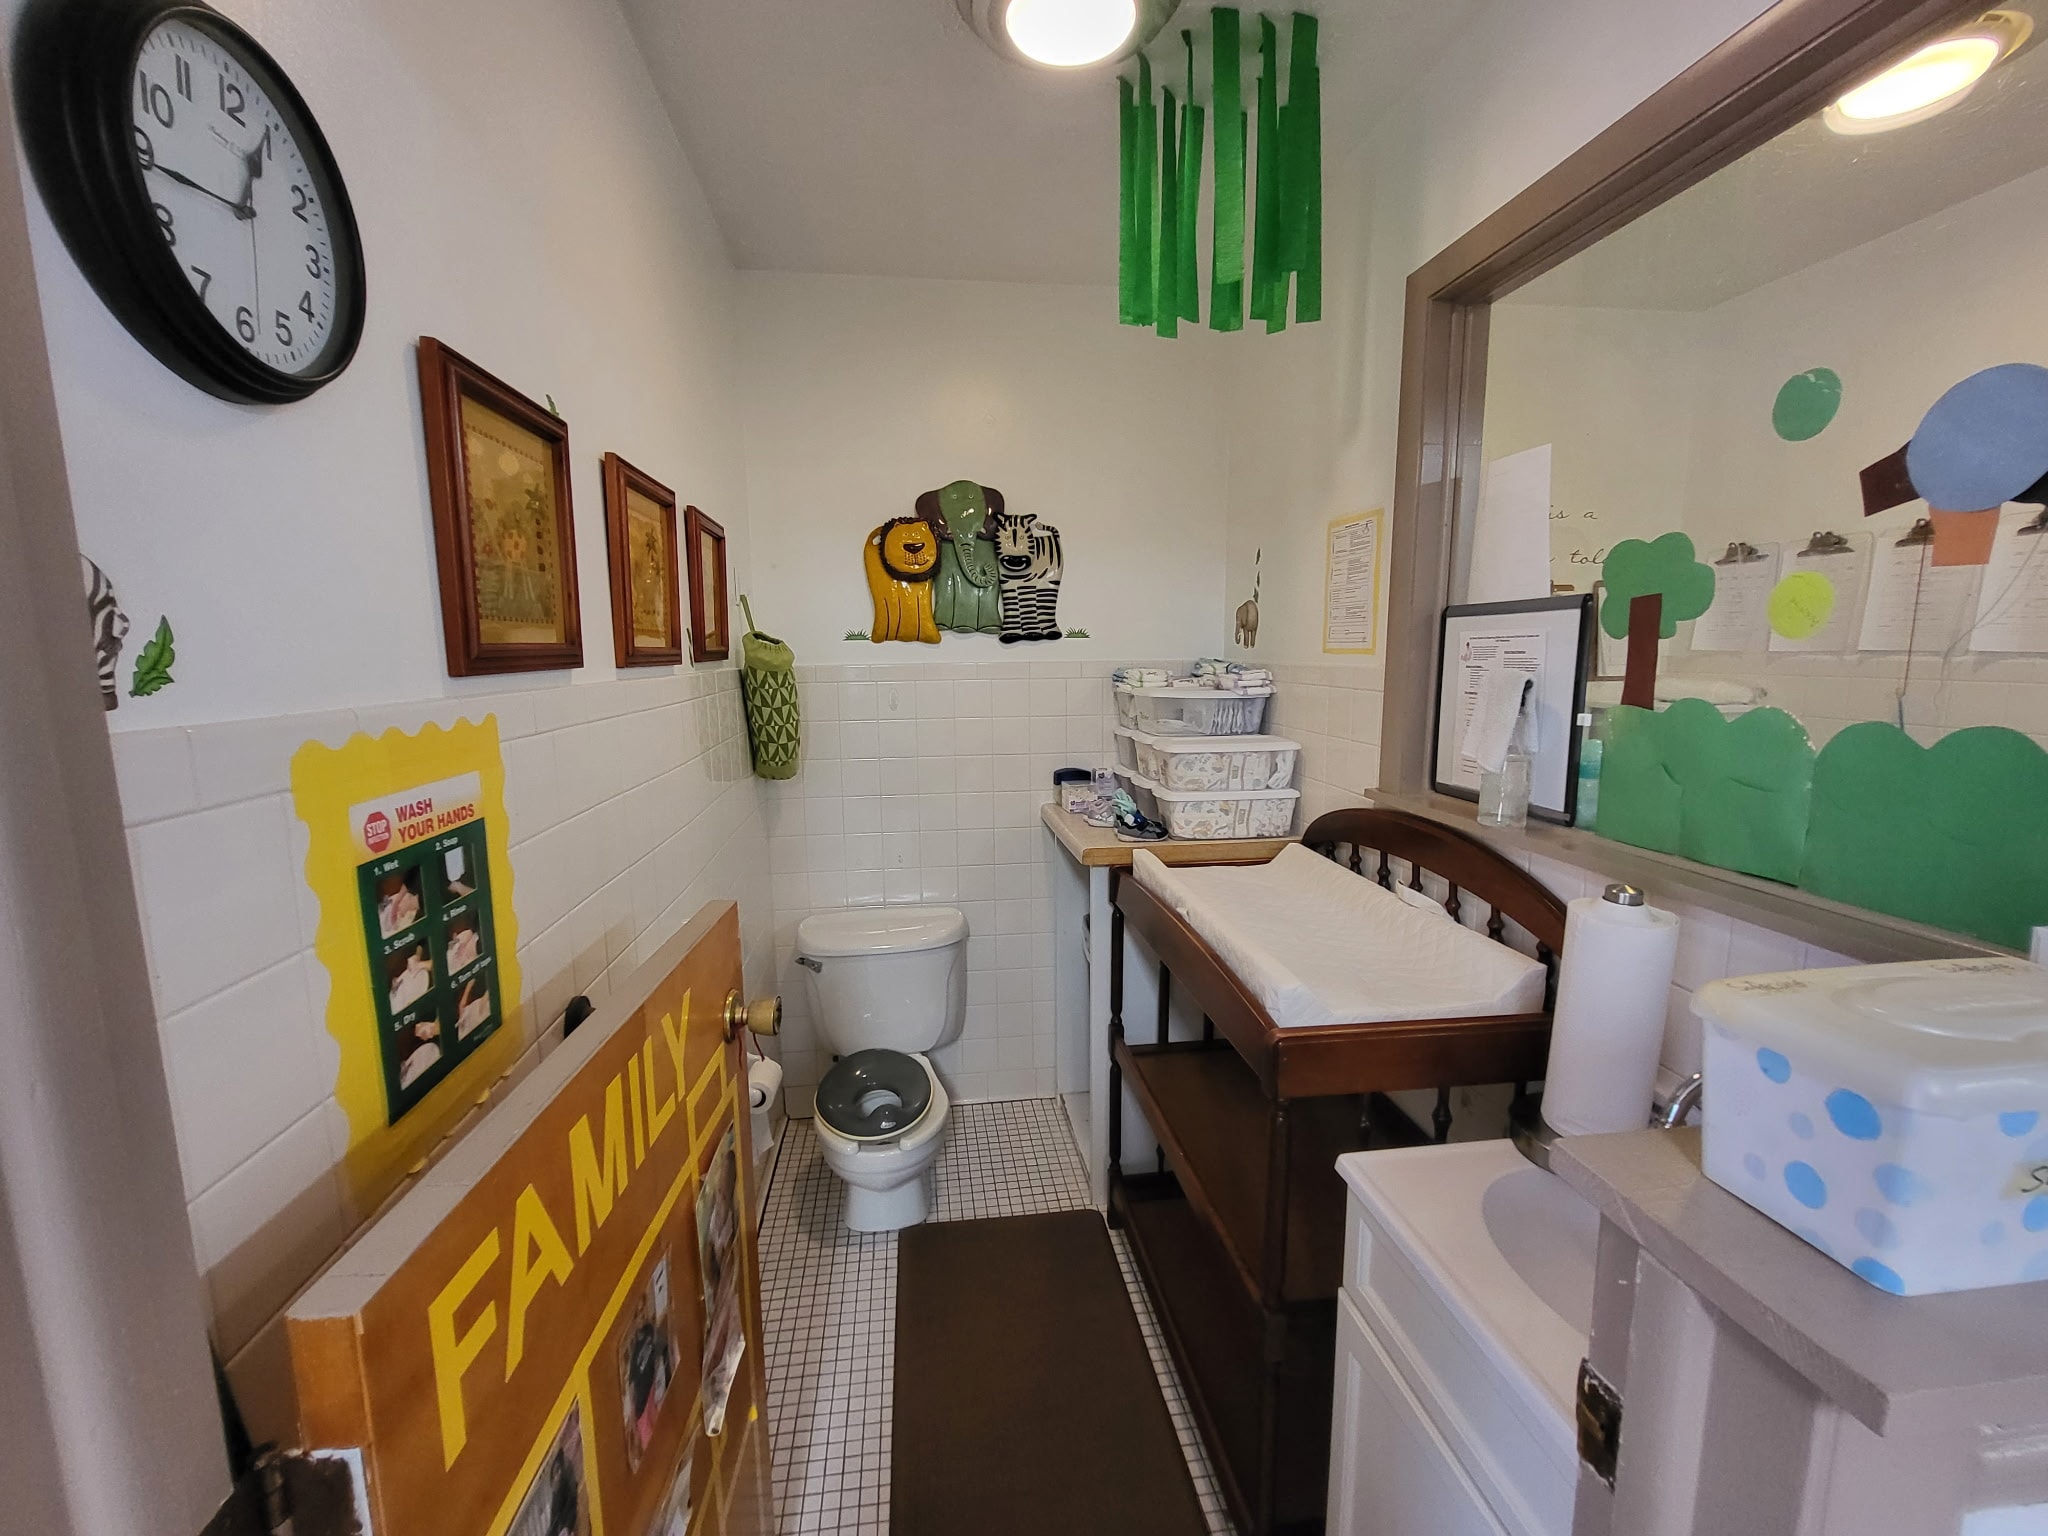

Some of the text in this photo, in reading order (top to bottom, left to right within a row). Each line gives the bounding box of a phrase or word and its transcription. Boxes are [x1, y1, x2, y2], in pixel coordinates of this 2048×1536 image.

[176, 54, 192, 102] 11
[140, 70, 174, 129] 10
[218, 73, 246, 128] 12
[134, 126, 154, 170] 9
[291, 184, 309, 223] 2
[153, 202, 176, 246] 8
[305, 244, 320, 280] 3
[191, 264, 211, 304] 7
[236, 306, 255, 343] 6
[299, 290, 315, 324] 4
[275, 310, 292, 347] 5
[1583, 511, 1598, 520] a
[366, 819, 388, 837] STOP
[395, 798, 433, 823] WASH
[398, 818, 435, 843] YOUR
[437, 803, 475, 830] HANDS
[428, 987, 691, 1472] FAMILY
